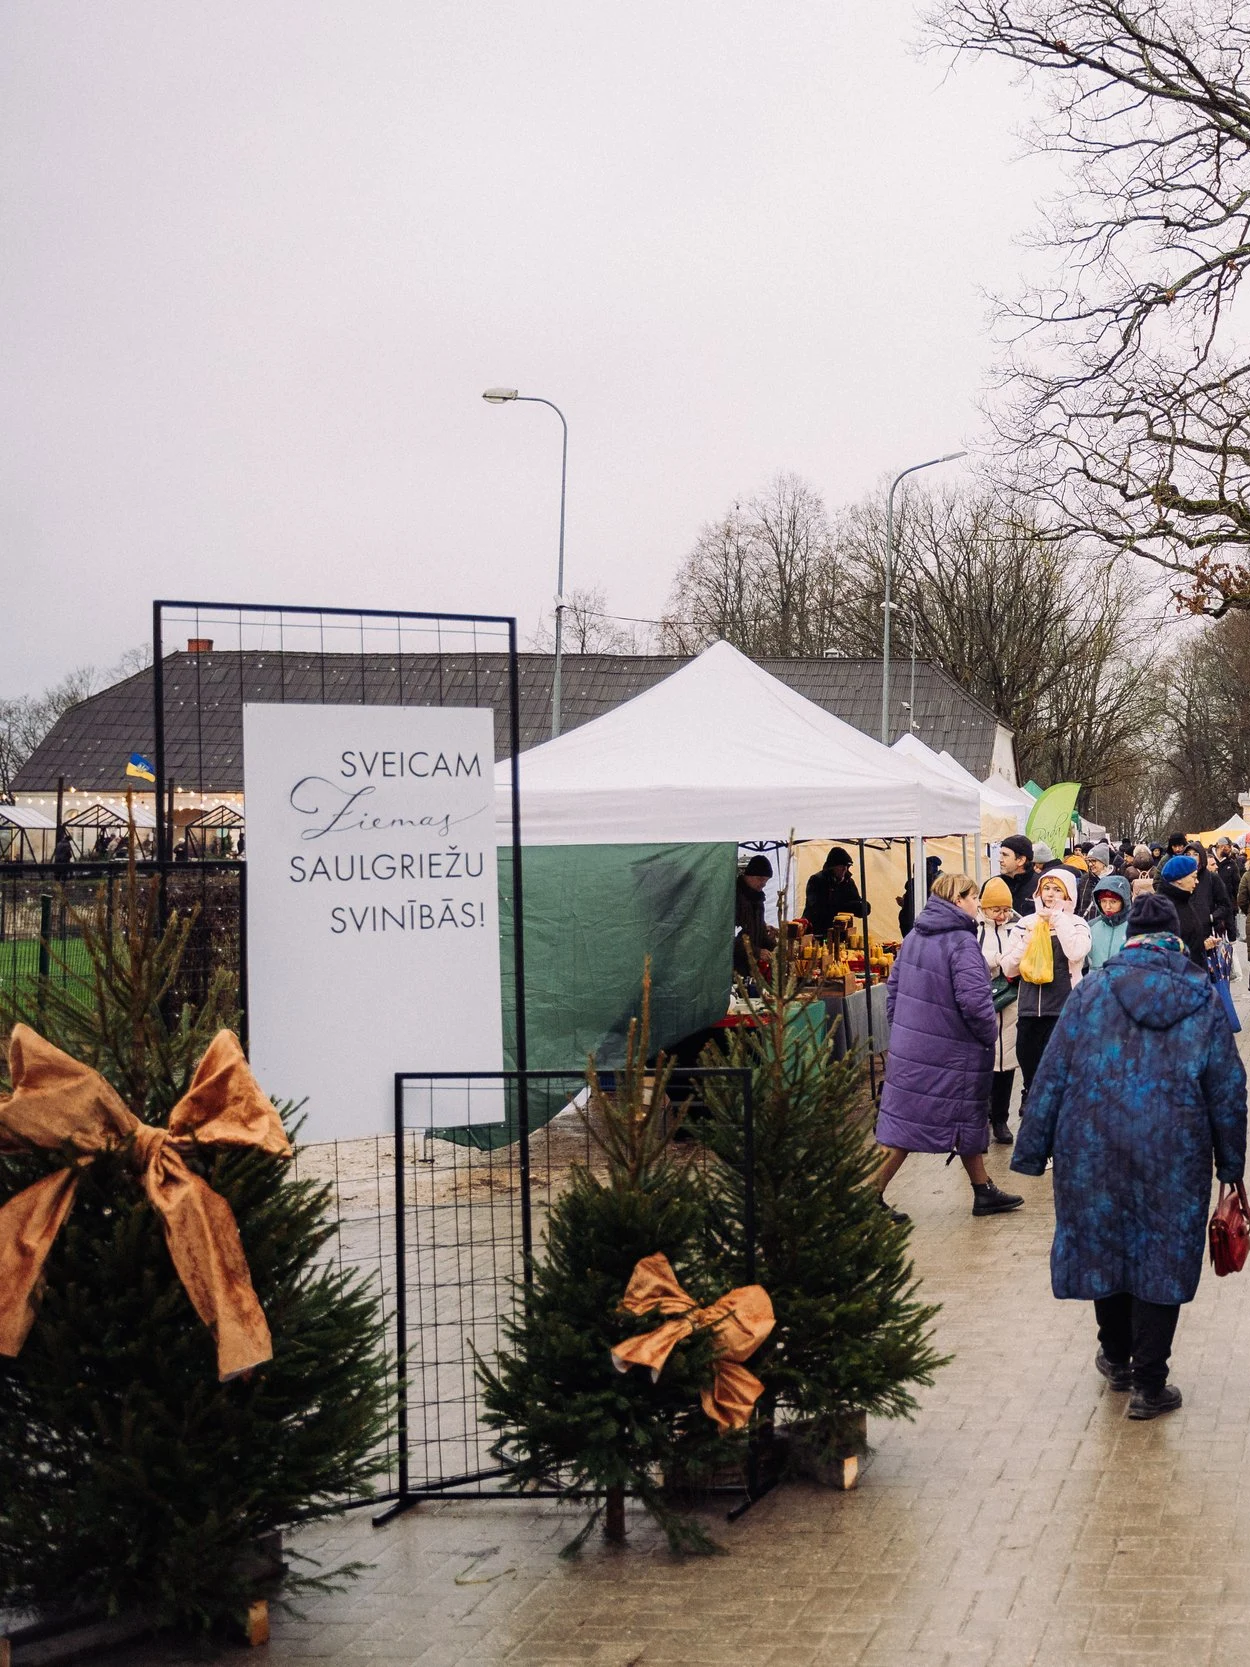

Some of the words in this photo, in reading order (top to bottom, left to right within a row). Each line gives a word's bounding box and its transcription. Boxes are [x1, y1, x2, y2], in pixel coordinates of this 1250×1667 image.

[341, 751, 482, 778] SVEICAM
[290, 776, 488, 840] Ziemas
[289, 845, 484, 882] SAULGRIEŽU
[330, 898, 485, 933] SVINĪBĀS!
